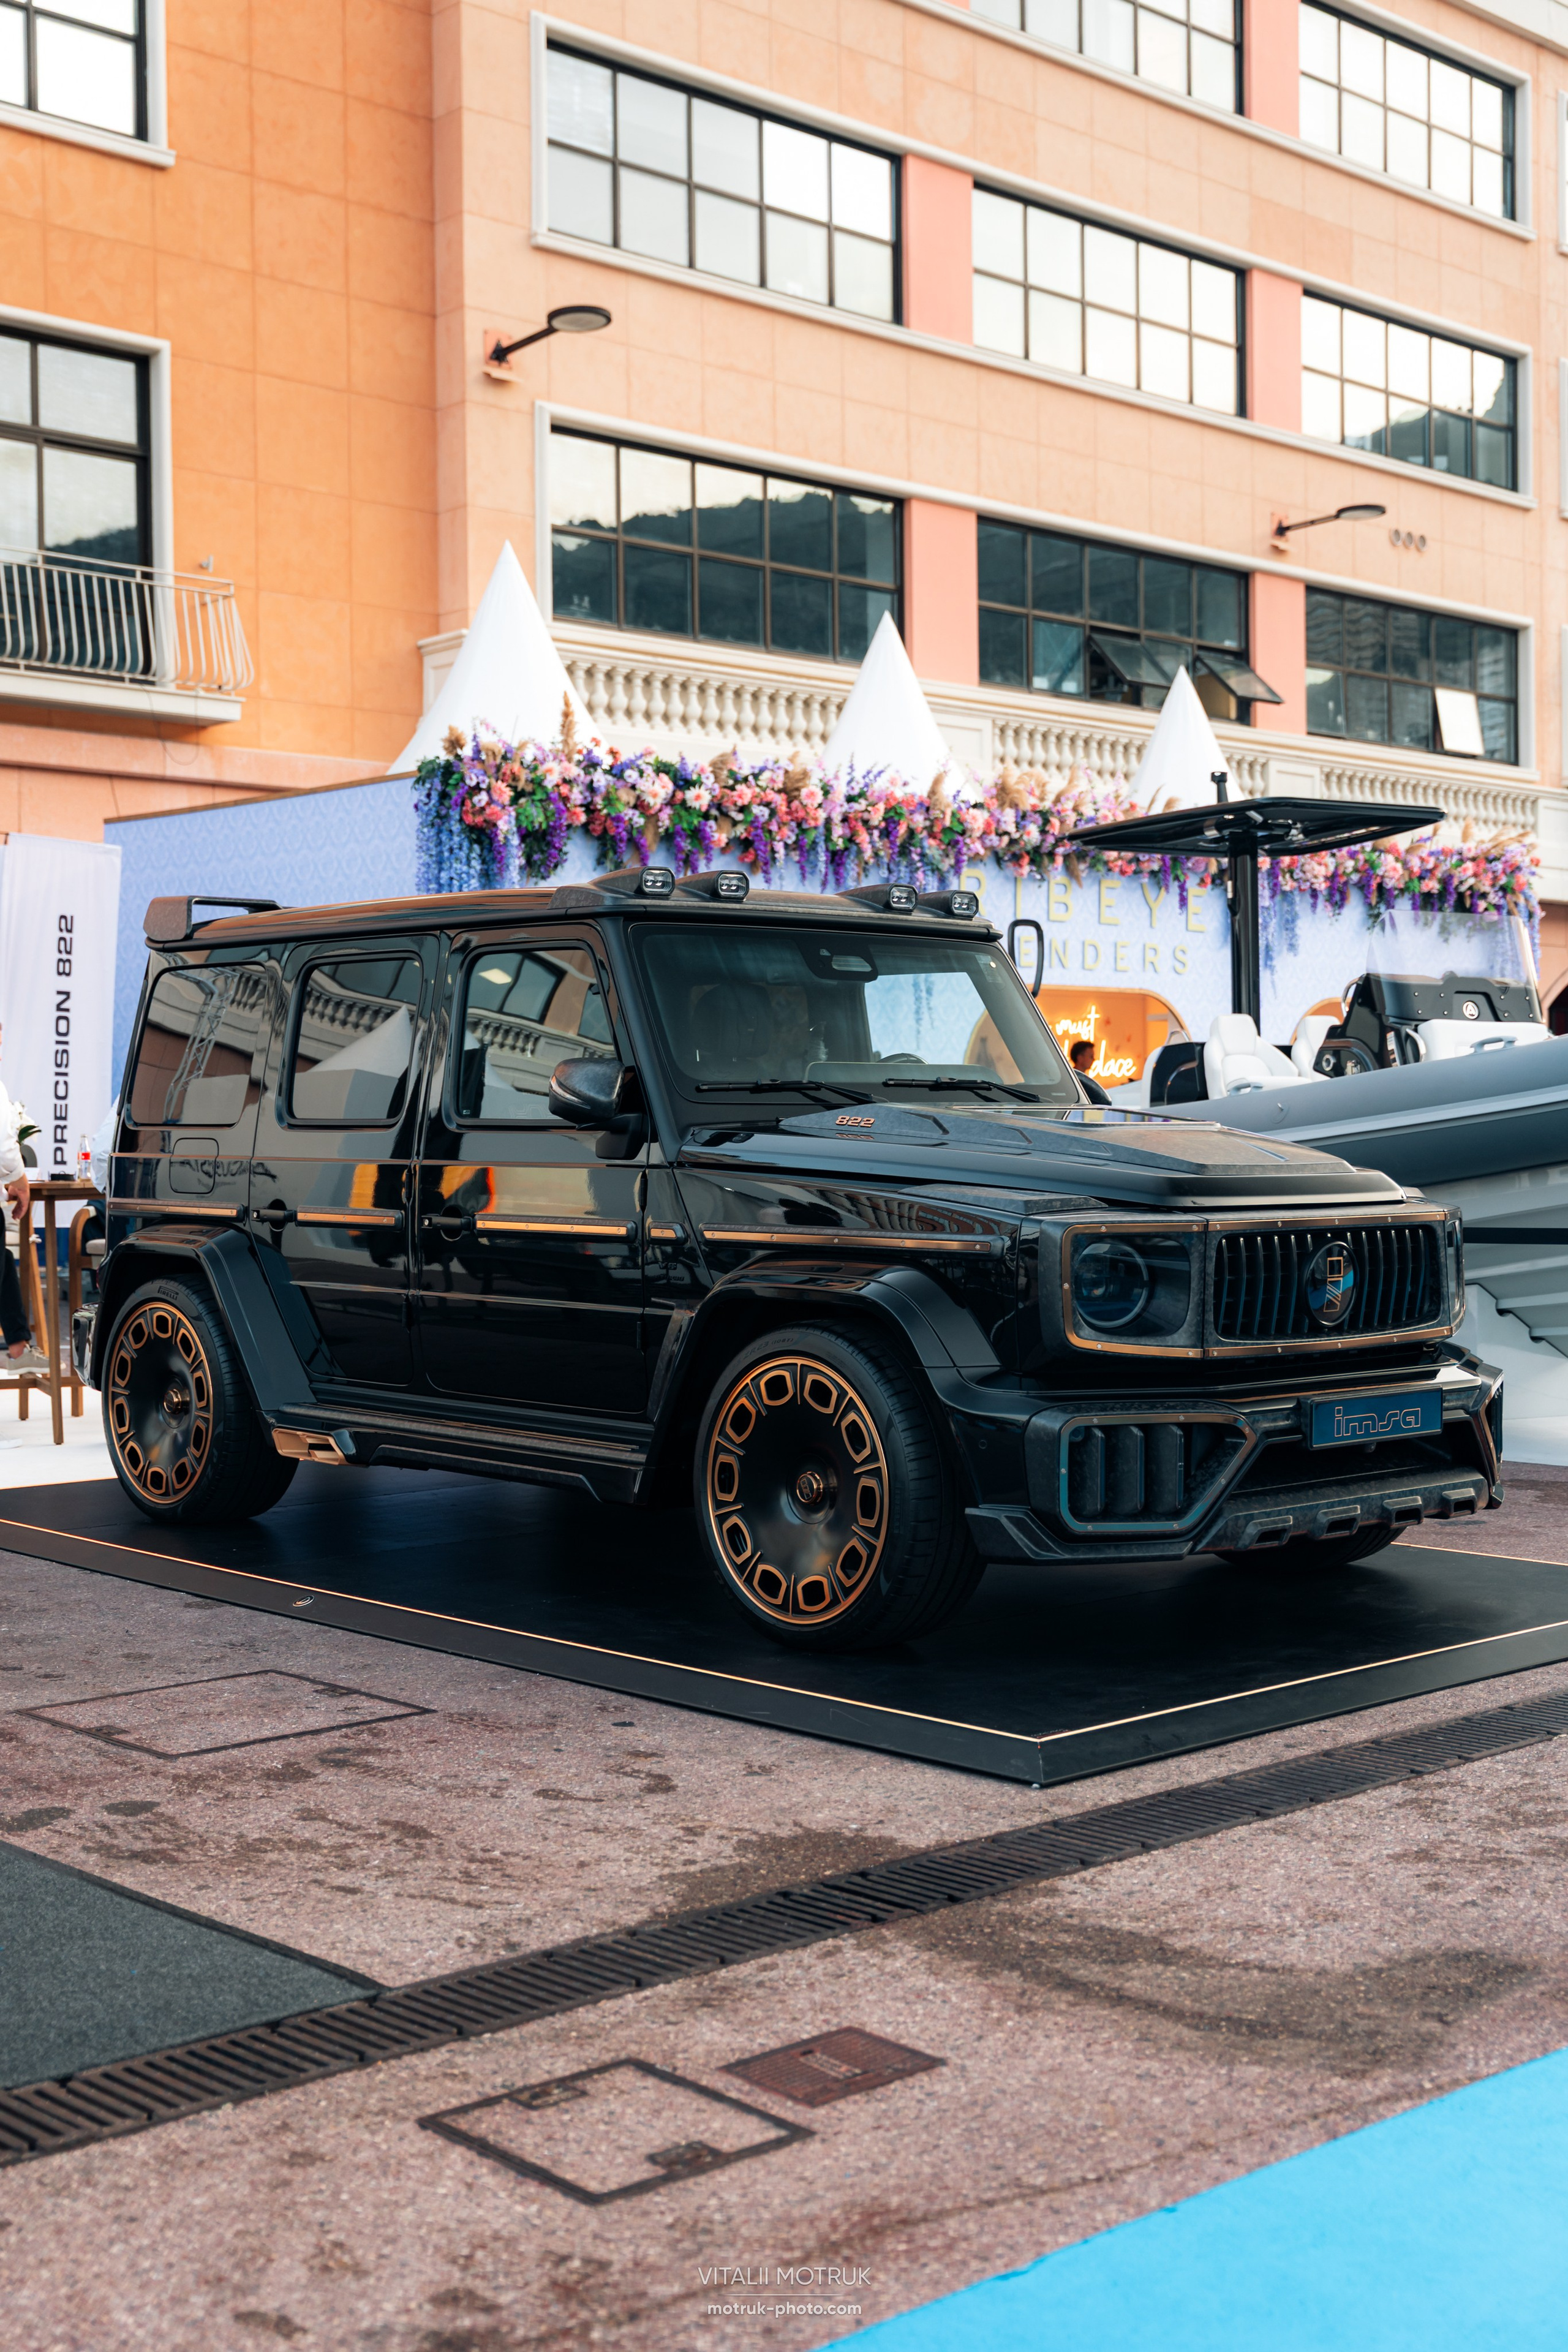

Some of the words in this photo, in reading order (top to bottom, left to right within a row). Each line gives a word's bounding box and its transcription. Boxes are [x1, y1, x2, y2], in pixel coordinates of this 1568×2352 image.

[960, 869, 1207, 932] RIBEYE
[56, 914, 74, 978] 822
[1019, 936, 1188, 975] ENDERS
[1055, 1005, 1101, 1042] must
[53, 989, 71, 1167] PRECISION
[835, 1115, 875, 1128] 822
[157, 1286, 179, 1300] PIRELLI
[1334, 1406, 1421, 1438] imsa
